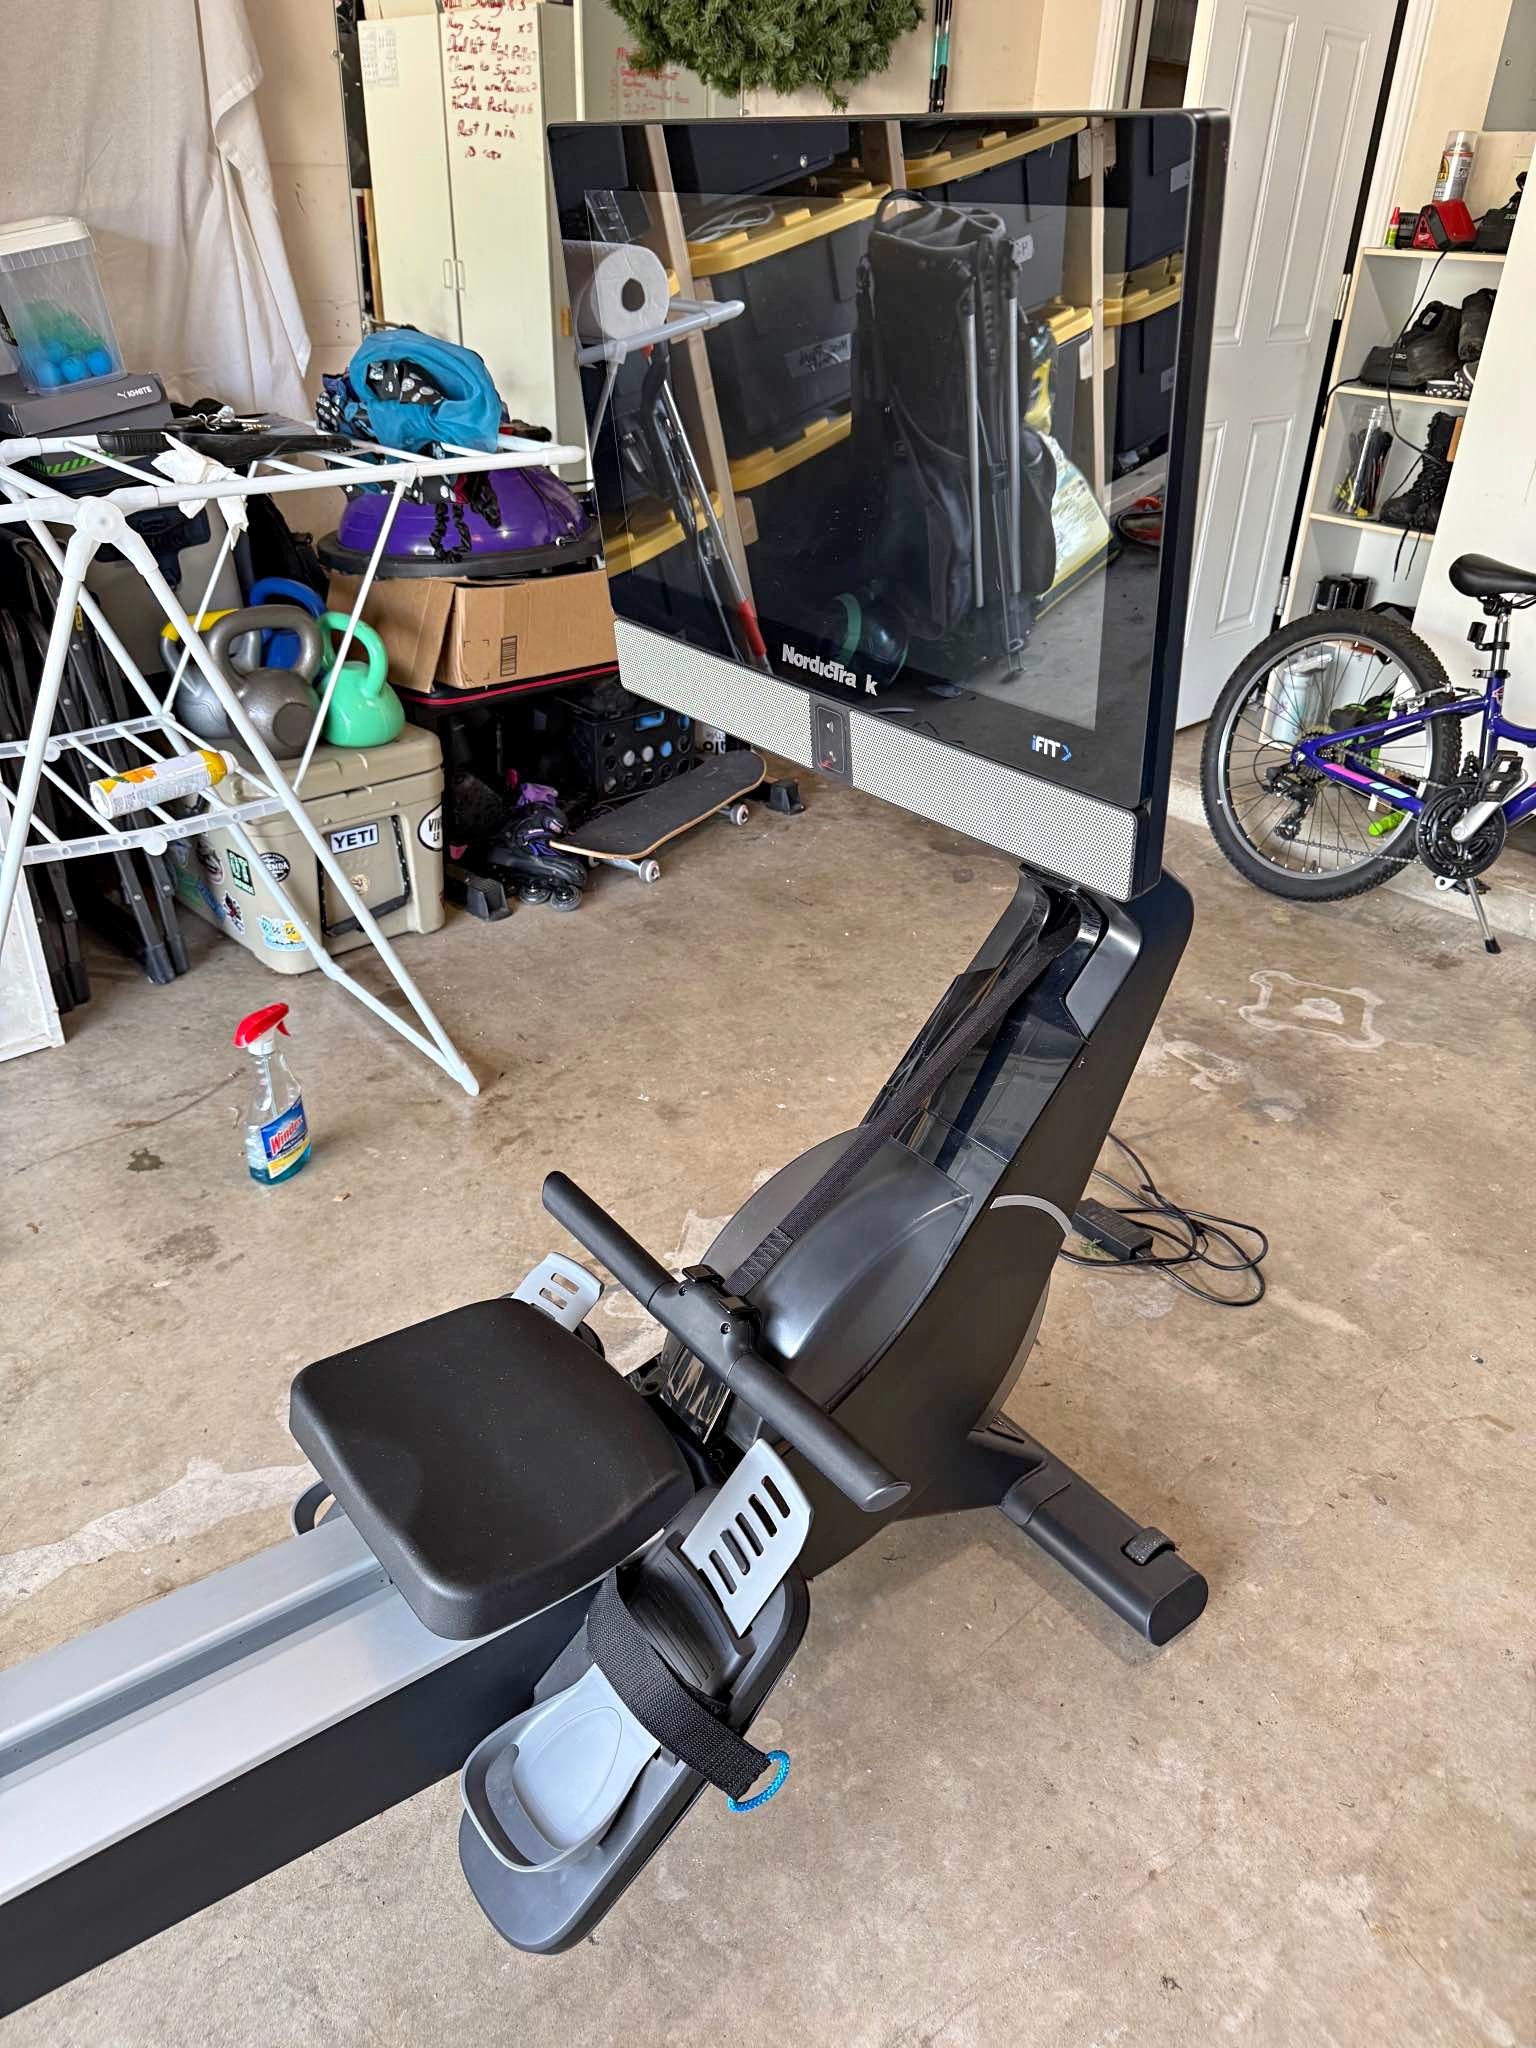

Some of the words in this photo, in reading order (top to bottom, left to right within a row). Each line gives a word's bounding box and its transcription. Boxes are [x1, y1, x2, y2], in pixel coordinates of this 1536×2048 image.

[469, 15, 501, 41] Swing
[457, 119, 480, 137] Rest
[495, 124, 516, 139] min
[782, 643, 878, 696] NordicTrak
[1032, 735, 1061, 758] iFIT
[333, 828, 375, 849] YETI
